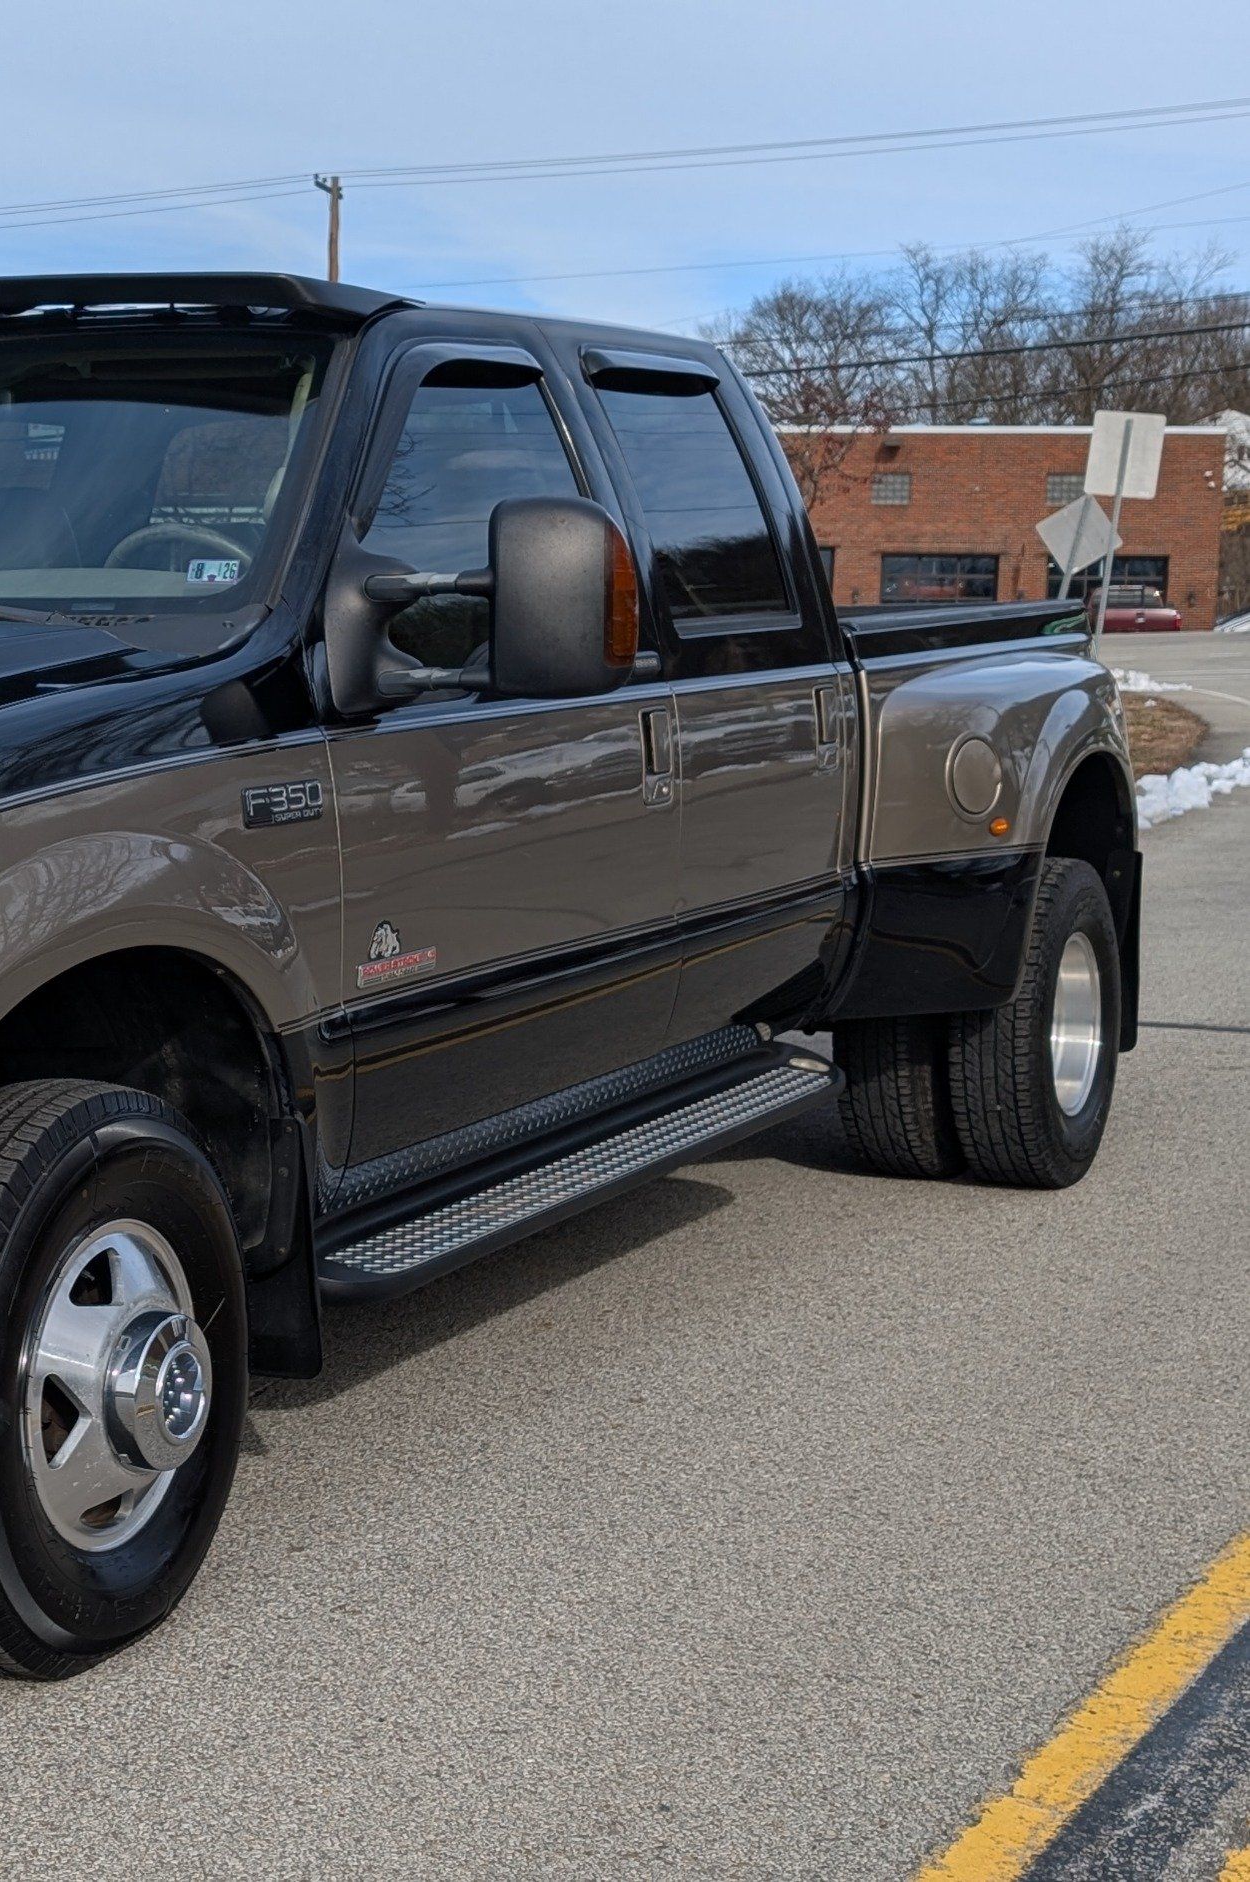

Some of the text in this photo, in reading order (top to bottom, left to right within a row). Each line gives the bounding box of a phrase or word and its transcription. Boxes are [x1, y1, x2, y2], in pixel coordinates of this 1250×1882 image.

[195, 562, 237, 579] 8 26
[274, 807, 324, 822] SUPER DUTY
